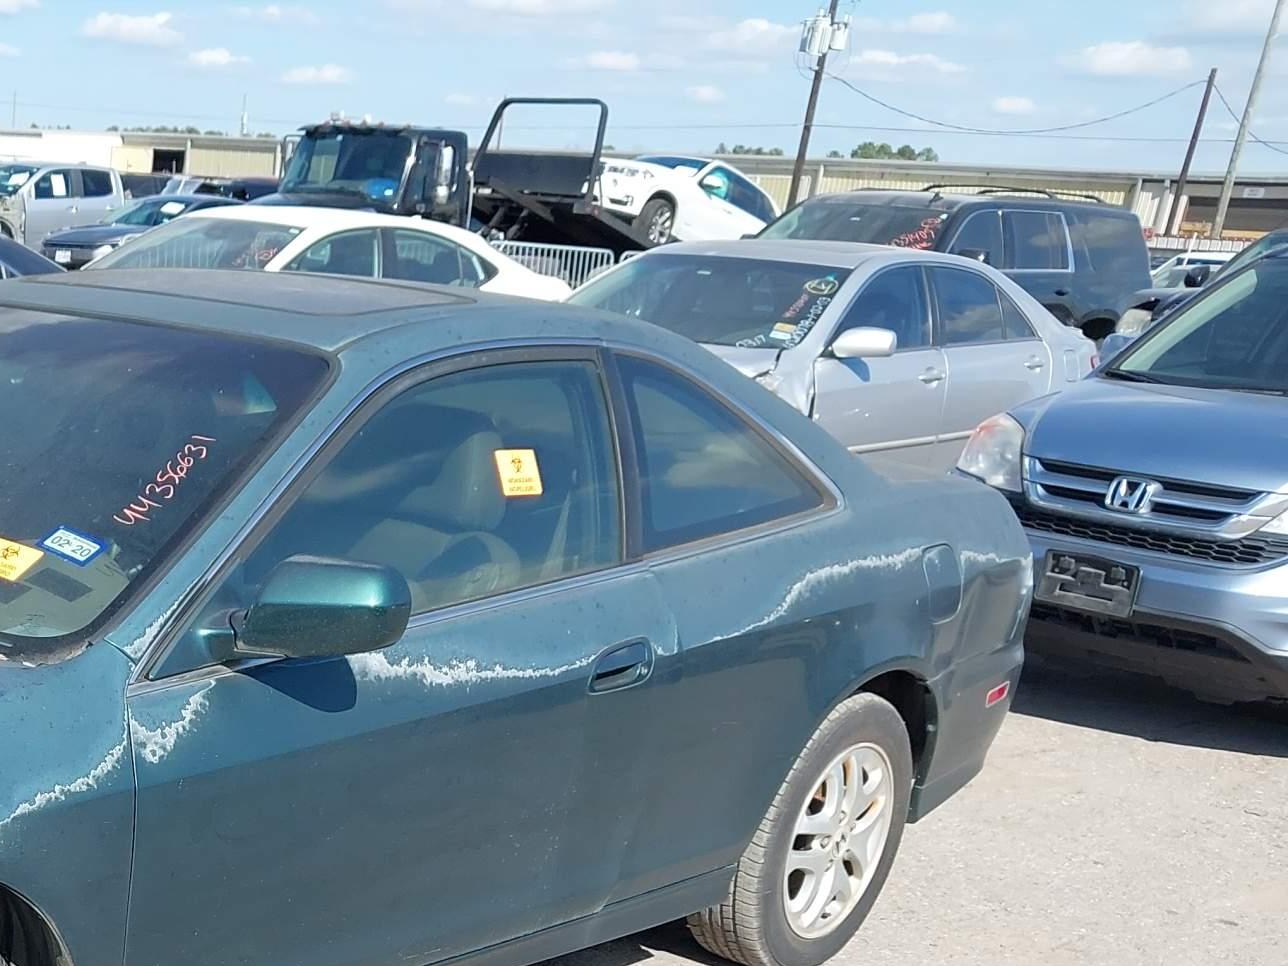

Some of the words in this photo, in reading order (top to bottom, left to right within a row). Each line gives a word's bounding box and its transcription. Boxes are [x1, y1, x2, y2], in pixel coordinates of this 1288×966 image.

[112, 434, 217, 525] 44356631
[50, 535, 70, 549] 02
[71, 544, 92, 558] 20
